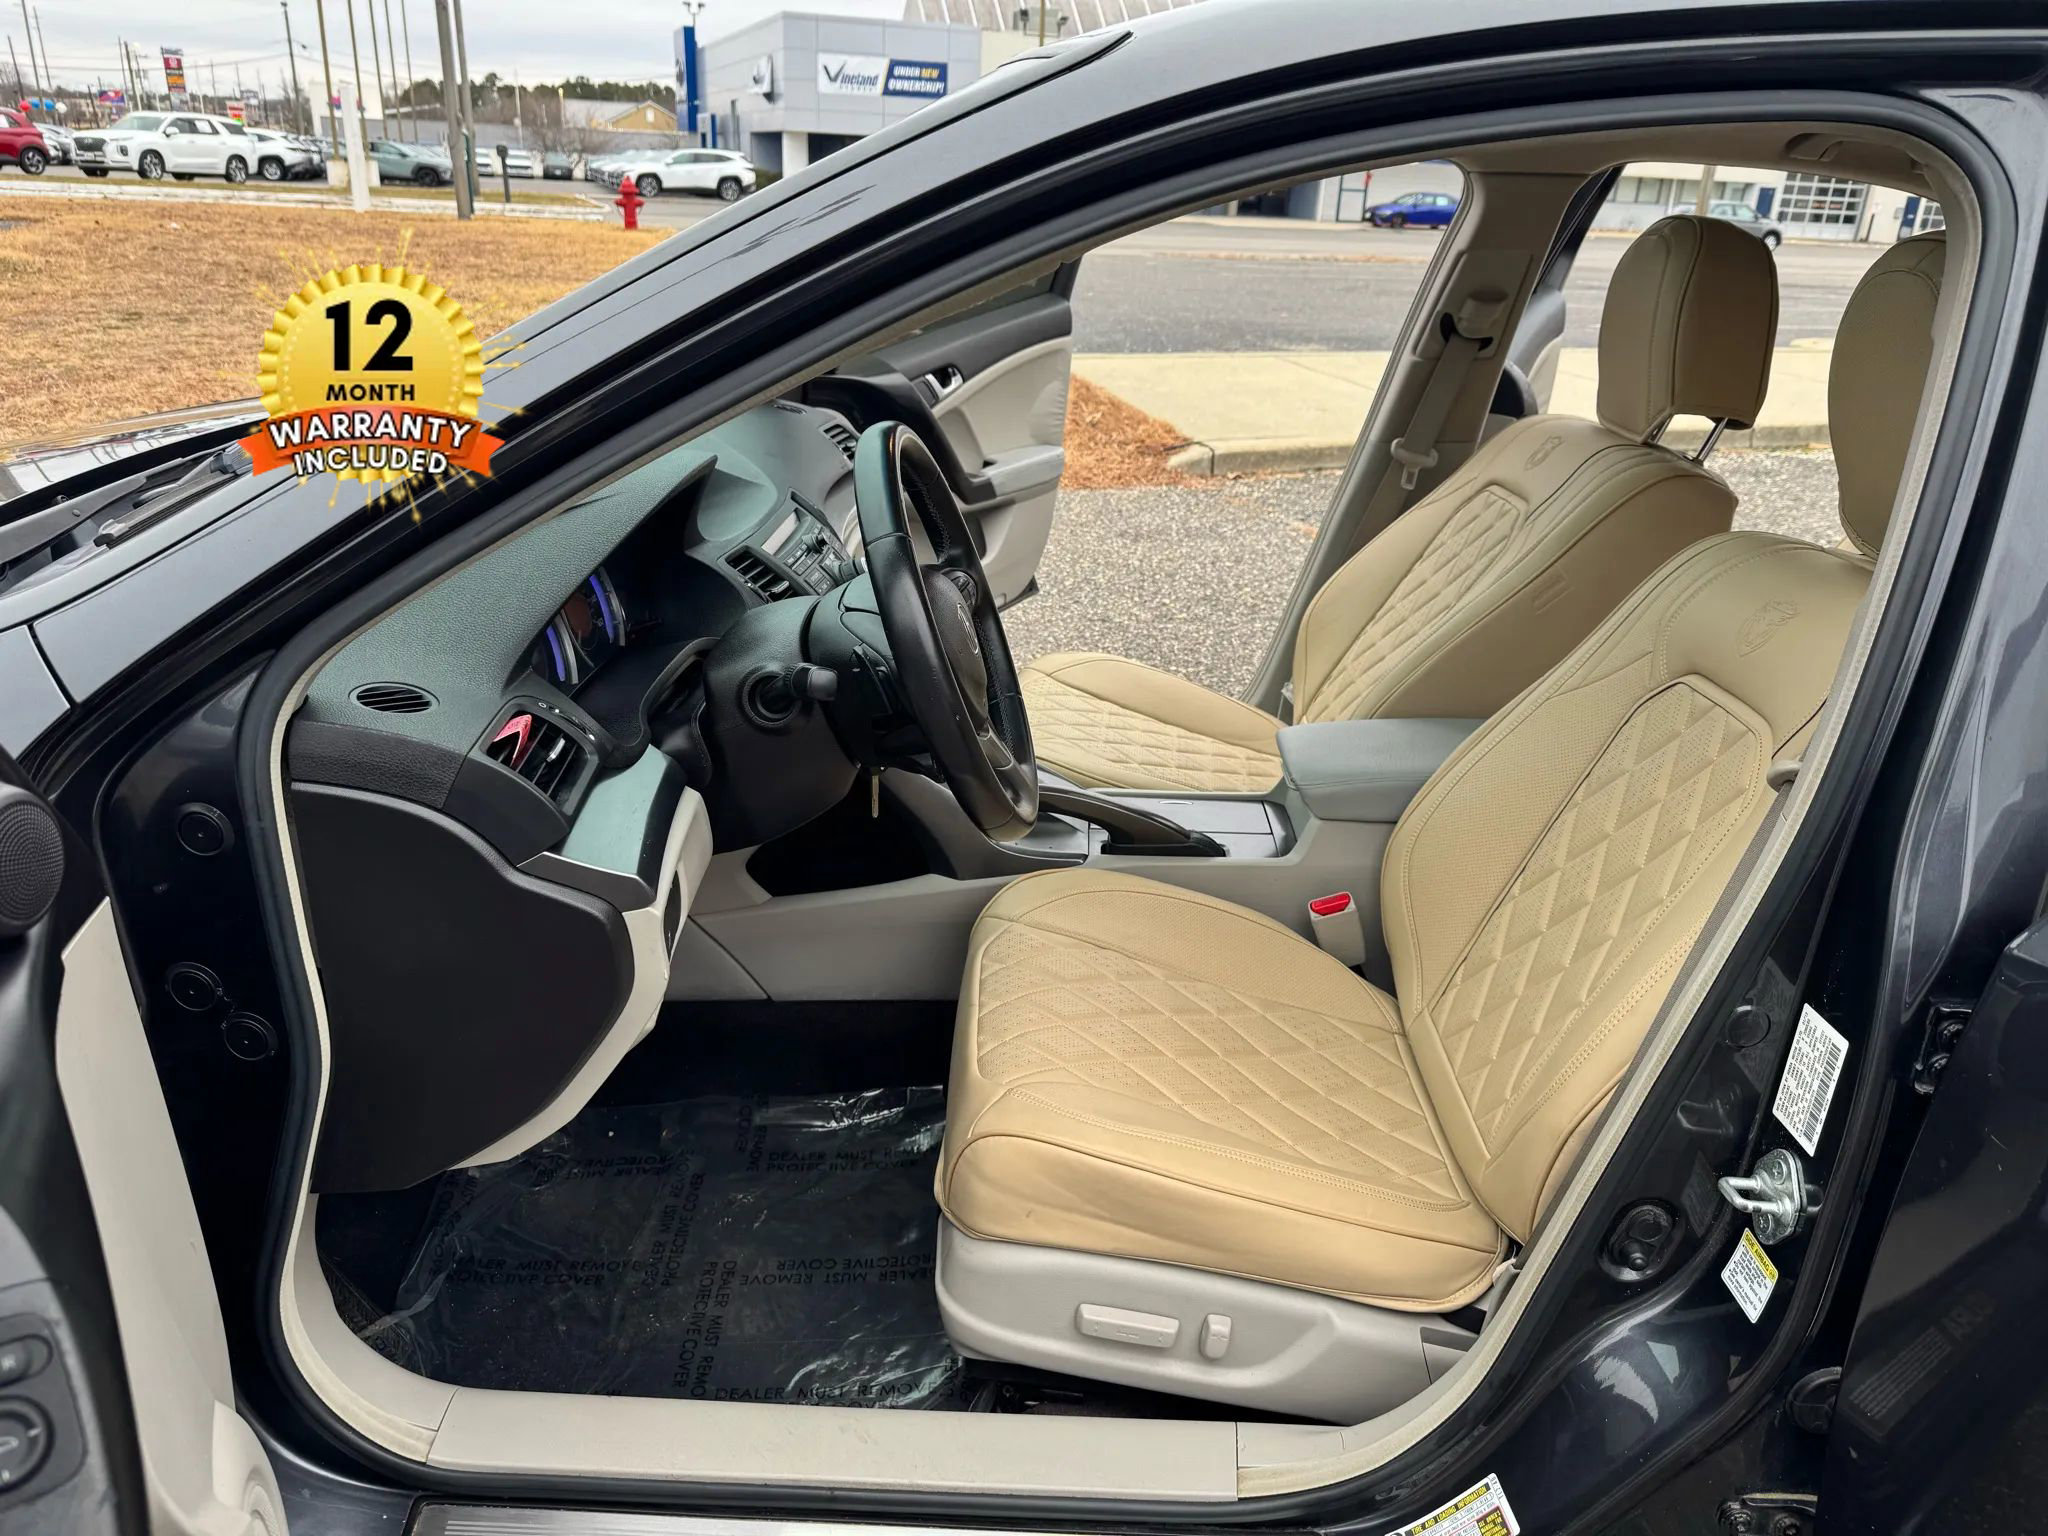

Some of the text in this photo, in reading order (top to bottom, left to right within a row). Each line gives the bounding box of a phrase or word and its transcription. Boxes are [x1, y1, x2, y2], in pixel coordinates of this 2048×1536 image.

[824, 60, 879, 86] Vineland
[893, 66, 939, 78] UNDER NEW
[888, 78, 944, 93] OWNERSHIP!
[1744, 1233, 1770, 1272] SIDE AIRBAG
[777, 1257, 838, 1271] COVER
[718, 1260, 738, 1309] DEALER
[738, 1273, 813, 1286] REMOVE
[823, 1271, 867, 1284] MUST
[704, 1314, 723, 1349] MUST
[713, 1386, 785, 1400] DEALER
[1412, 1524, 1423, 1536] TIRE
[1424, 1517, 1435, 1528] AND
[1436, 1505, 1457, 1521] LOADING
[1456, 1485, 1487, 1509] INFORMATION
